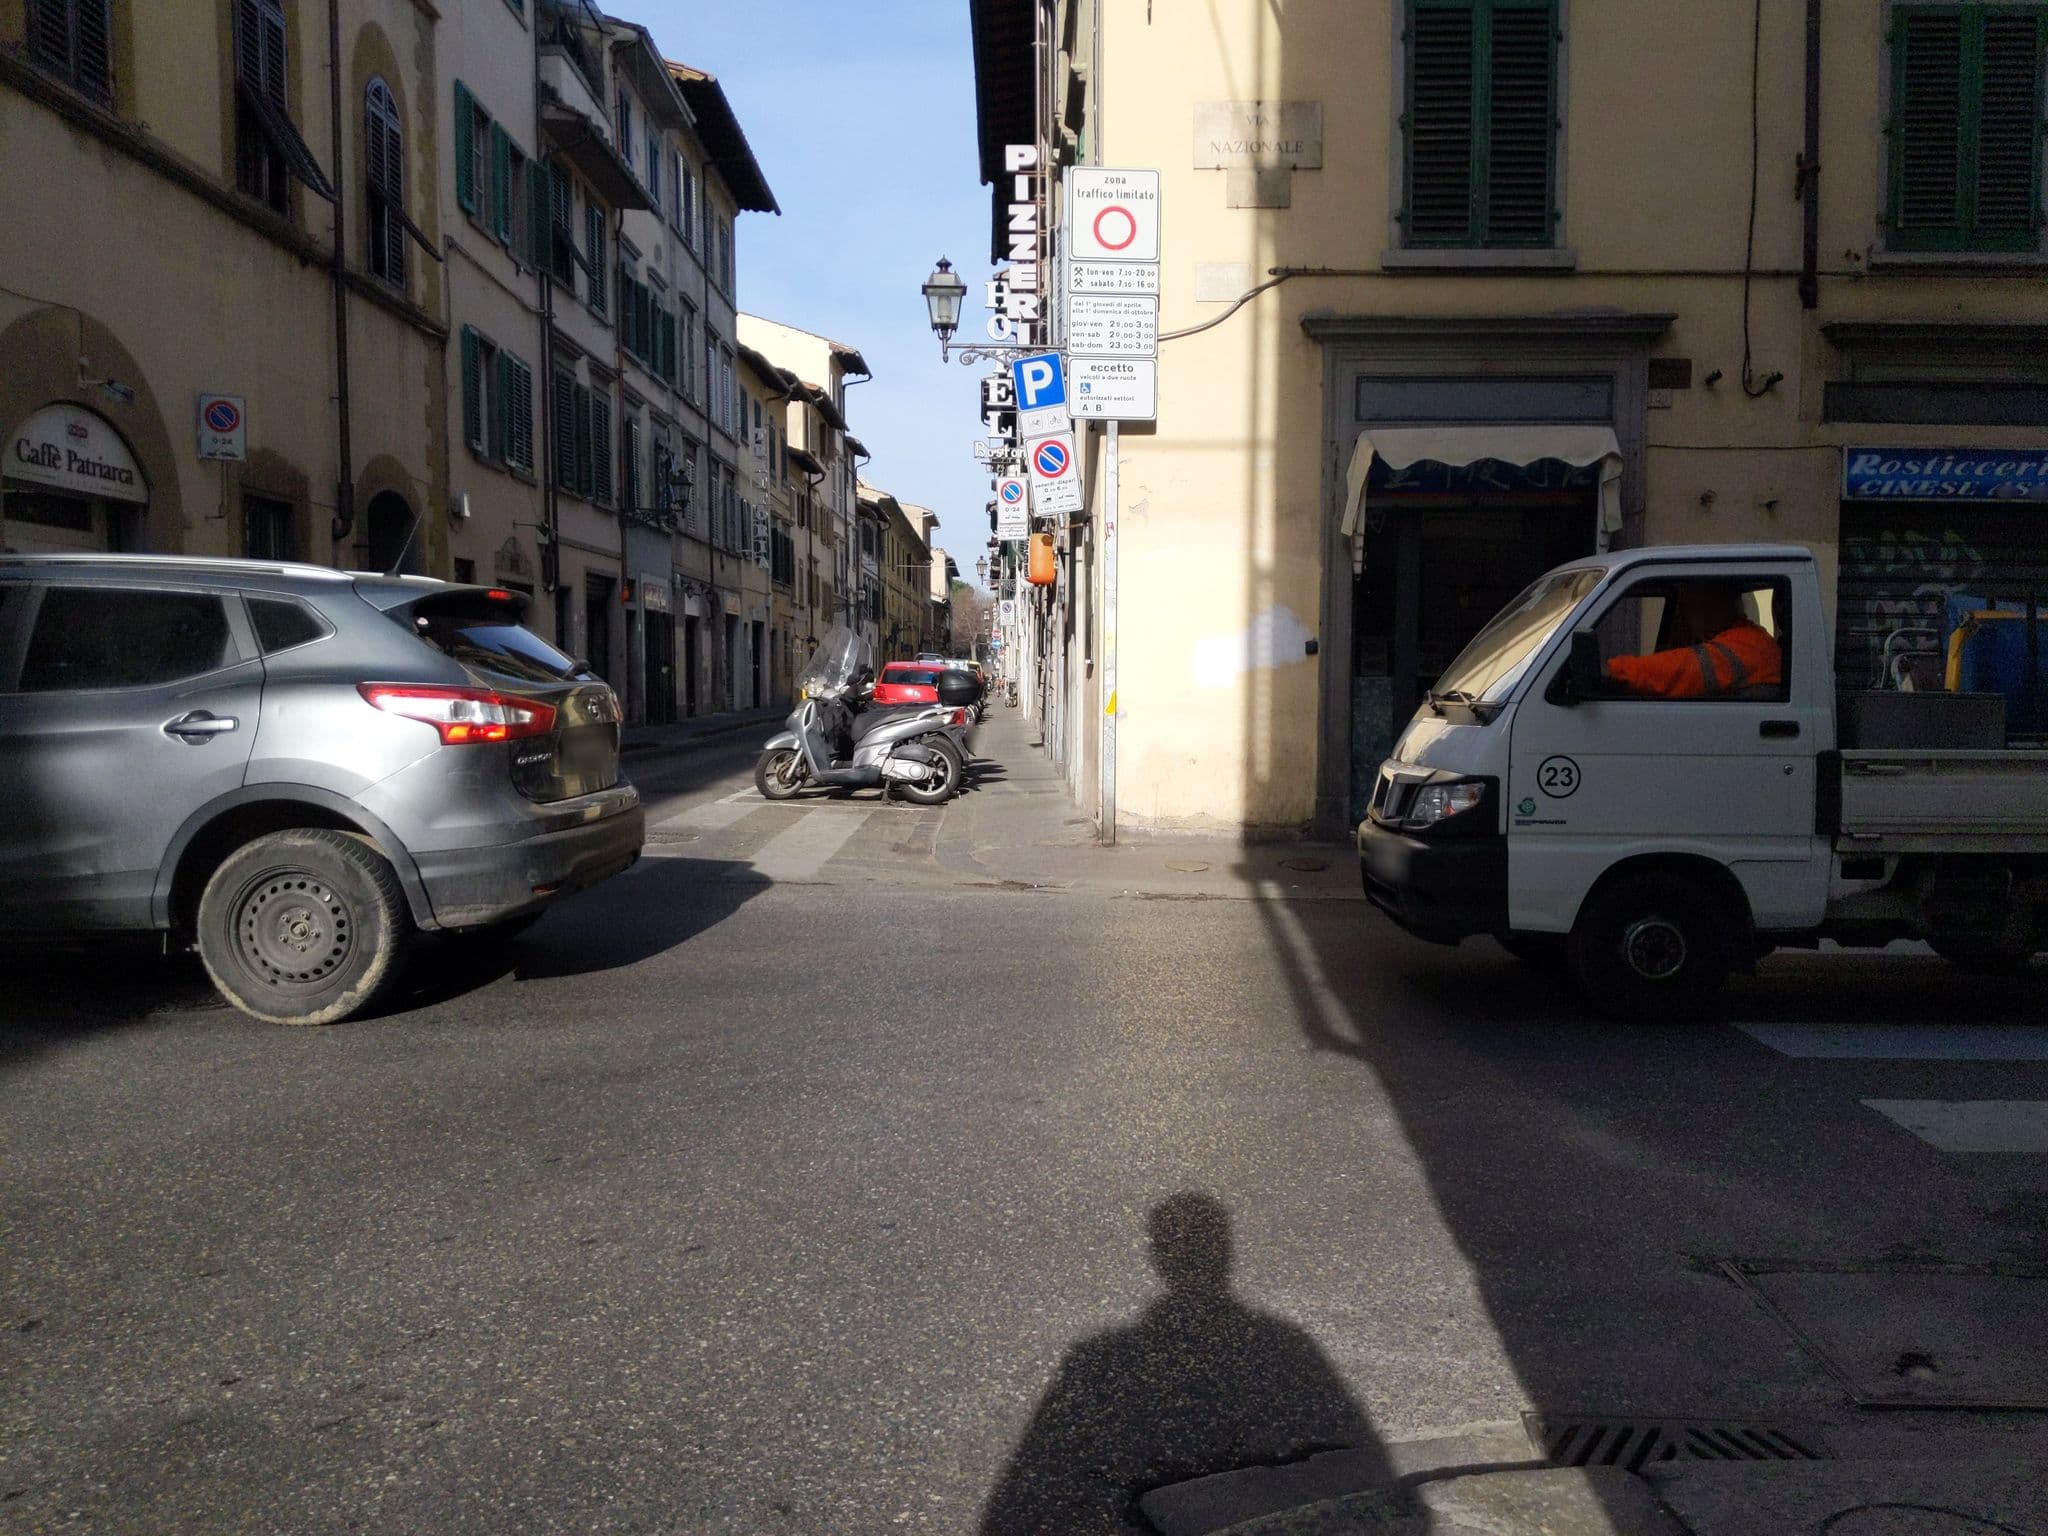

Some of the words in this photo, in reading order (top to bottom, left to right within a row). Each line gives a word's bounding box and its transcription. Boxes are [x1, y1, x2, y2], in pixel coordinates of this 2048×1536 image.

[1246, 115, 1270, 128] VIA
[1210, 141, 1304, 154] NAZIONALE
[1104, 176, 1127, 184] zona
[1077, 188, 1113, 199] traffico
[1116, 189, 1154, 200] limitato
[1005, 144, 1038, 376] PIZZERI
[1090, 363, 1134, 373] eccetto
[1022, 360, 1053, 406] P
[1082, 404, 1089, 412] A
[1095, 404, 1102, 412] B
[974, 440, 1026, 459] Boston
[16, 438, 62, 470] Caffè
[67, 449, 134, 486] Patriarca
[1544, 766, 1573, 787] 23
